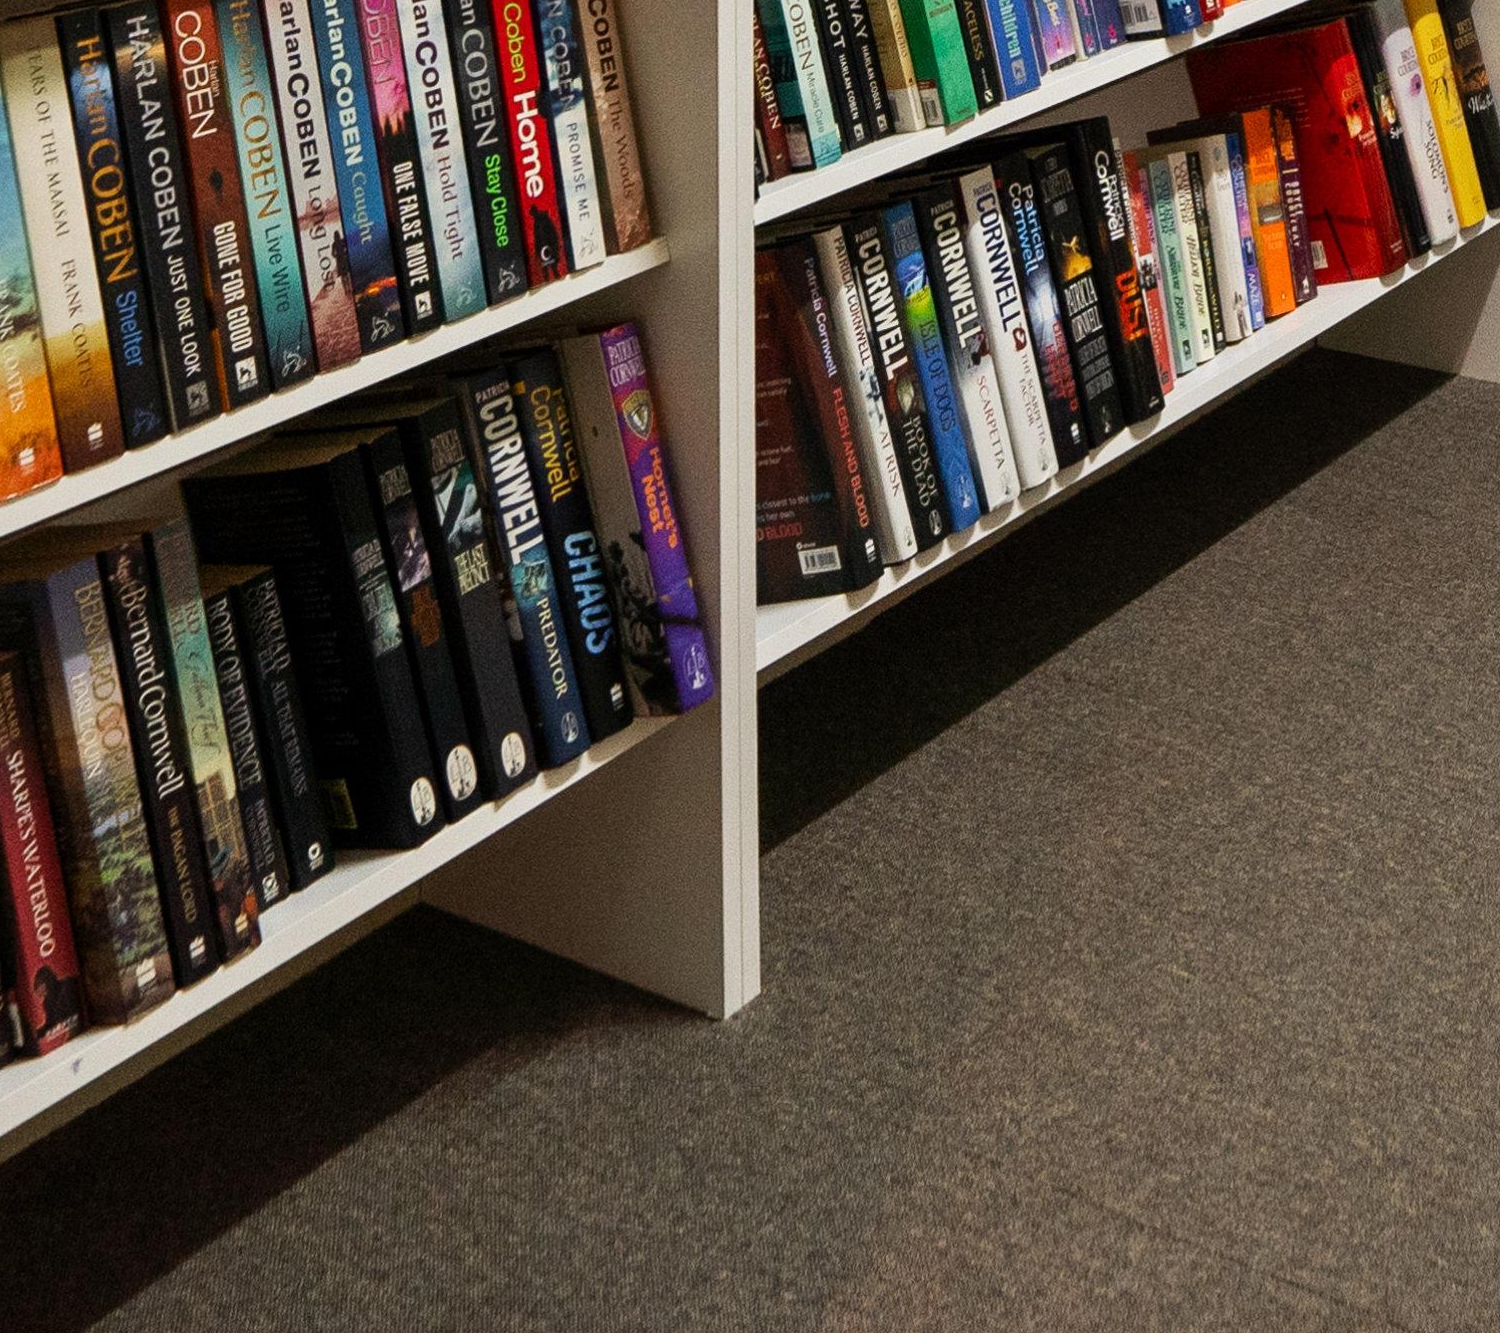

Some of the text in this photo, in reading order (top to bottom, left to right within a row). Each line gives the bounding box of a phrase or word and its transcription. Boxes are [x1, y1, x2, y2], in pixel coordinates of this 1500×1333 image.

[174, 9, 218, 140] COBEN
[502, 2, 526, 84] Coben
[125, 14, 184, 250] HARLAN COBEN
[512, 90, 544, 199] Home
[487, 153, 510, 249] Stay Close
[115, 289, 145, 369] Shelter
[1115, 270, 1144, 341] DUST
[975, 375, 1005, 471] SCARPETTA
[479, 395, 547, 564] CORNWELL
[564, 531, 612, 654] CHAOS
[537, 597, 567, 700] PREDATOR
